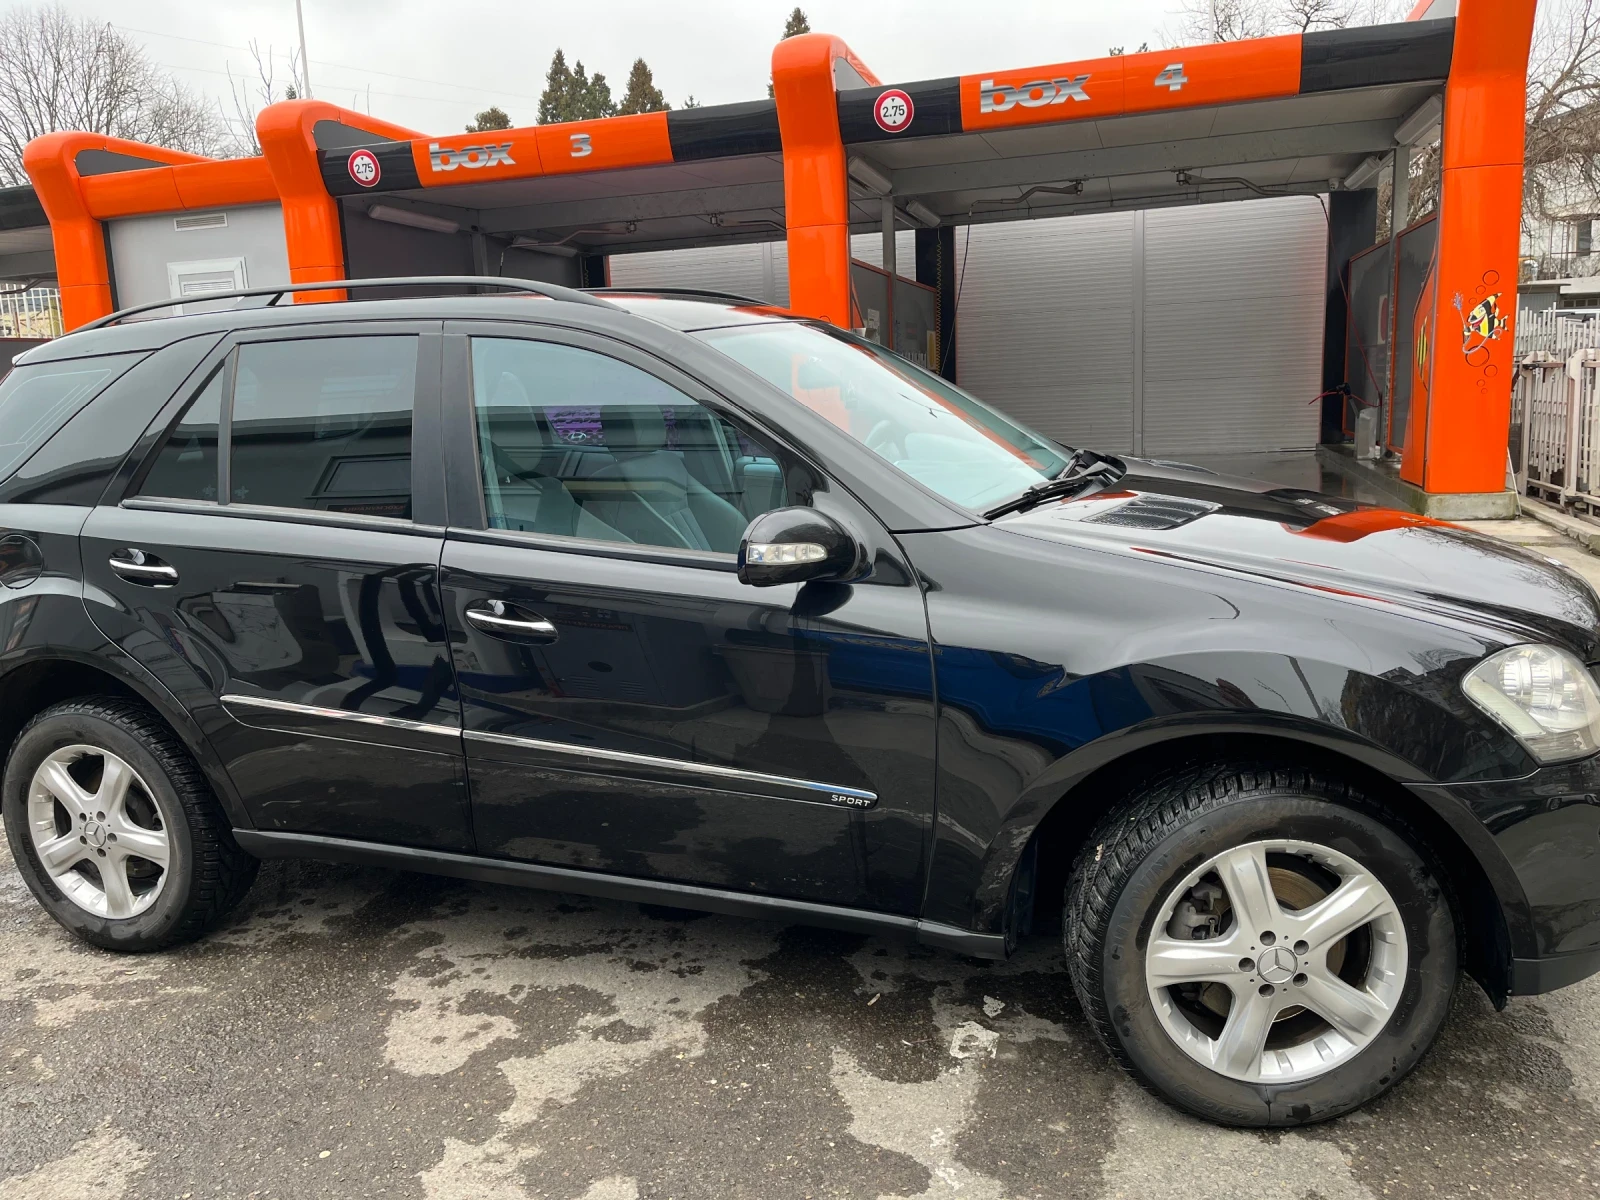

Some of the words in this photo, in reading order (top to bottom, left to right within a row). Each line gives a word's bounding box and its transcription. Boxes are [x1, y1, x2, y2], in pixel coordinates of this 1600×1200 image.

[980, 73, 1092, 114] box
[1154, 62, 1188, 91] 4
[880, 104, 906, 118] 2.75
[428, 142, 517, 172] box
[569, 133, 593, 158] 3
[355, 163, 374, 174] 2.75
[830, 794, 871, 807] SPORT
